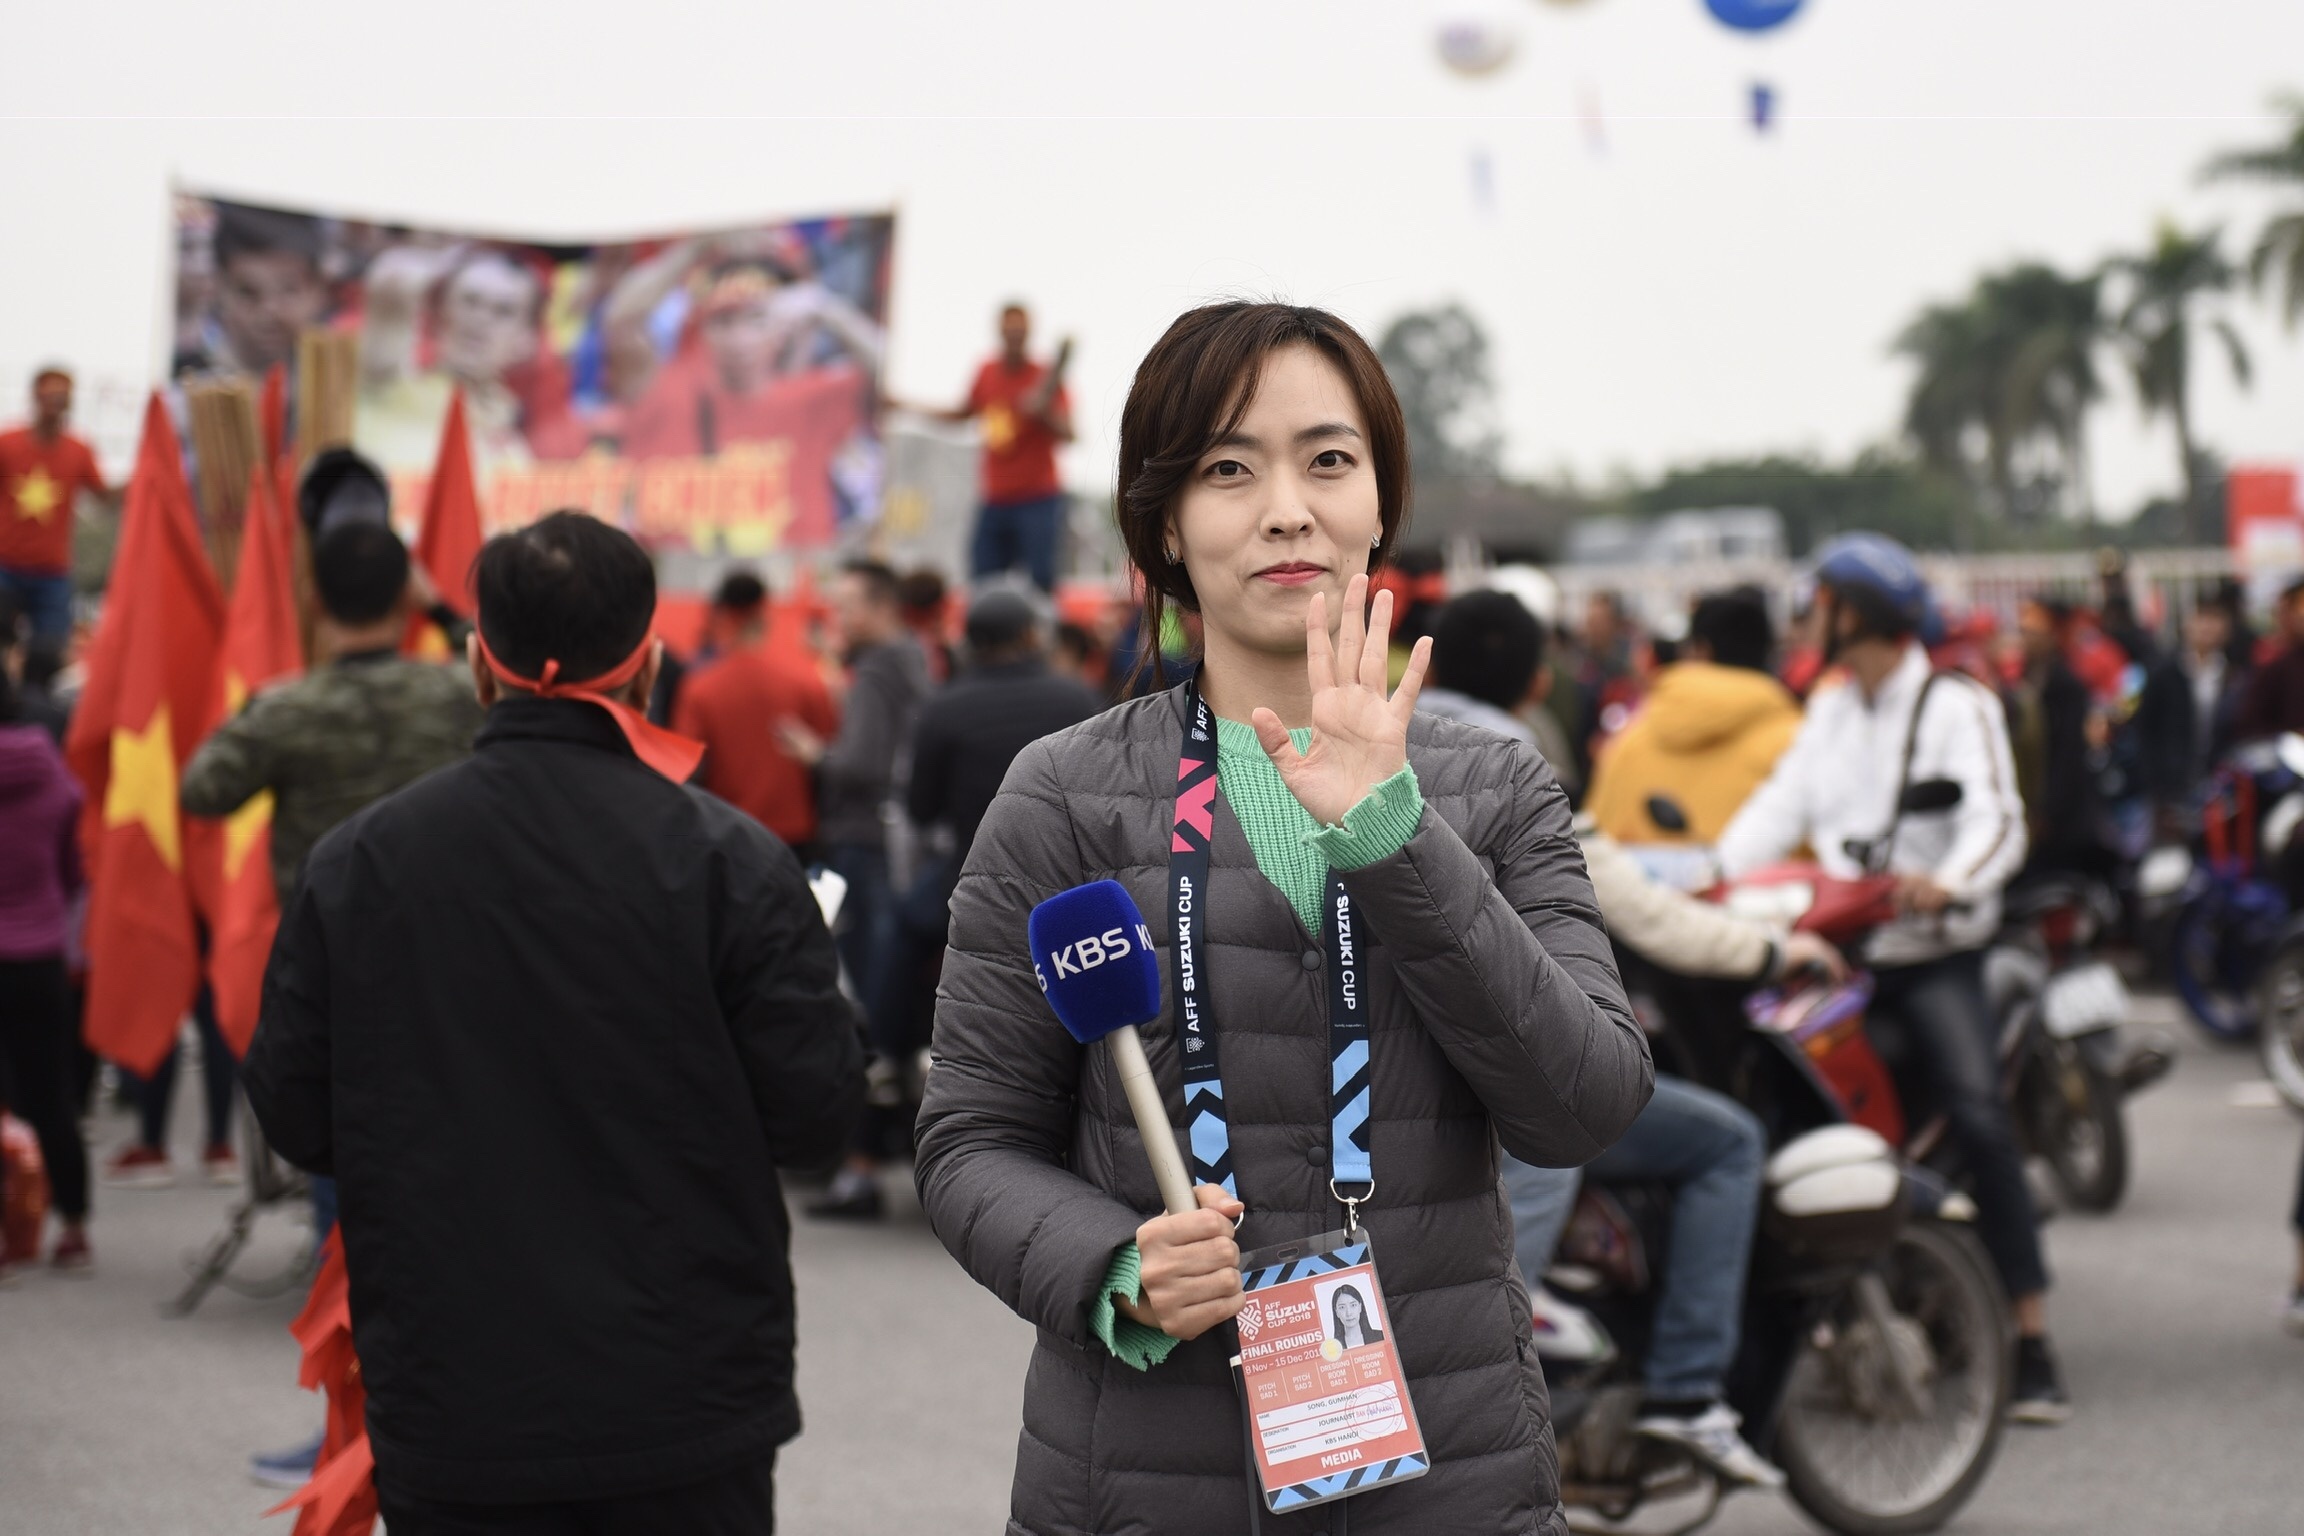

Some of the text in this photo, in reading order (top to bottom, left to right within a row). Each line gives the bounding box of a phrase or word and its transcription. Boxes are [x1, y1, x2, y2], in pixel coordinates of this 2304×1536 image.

[1196, 702, 1208, 730] AFF
[1336, 895, 1354, 966] SUZUKI
[1051, 927, 1131, 980] KBS
[1178, 875, 1200, 1033] AFF SUZUKI CUP
[1341, 970, 1356, 1010] CUP
[1264, 1301, 1280, 1311] AFF
[1265, 1300, 1316, 1321] SUZUKI
[1267, 1311, 1312, 1329] CUP 2018
[1241, 1330, 1323, 1360] FINAL ROUNDS
[1252, 1362, 1268, 1373] Nov
[1286, 1354, 1303, 1365] Dec
[1361, 1360, 1381, 1371] ROOM
[1292, 1372, 1311, 1384] PITCH
[1327, 1368, 1347, 1380] ROOM
[1257, 1381, 1277, 1393] PITCH
[1318, 1412, 1356, 1427] JOURNALIST
[1320, 1447, 1363, 1469] MEDIA
